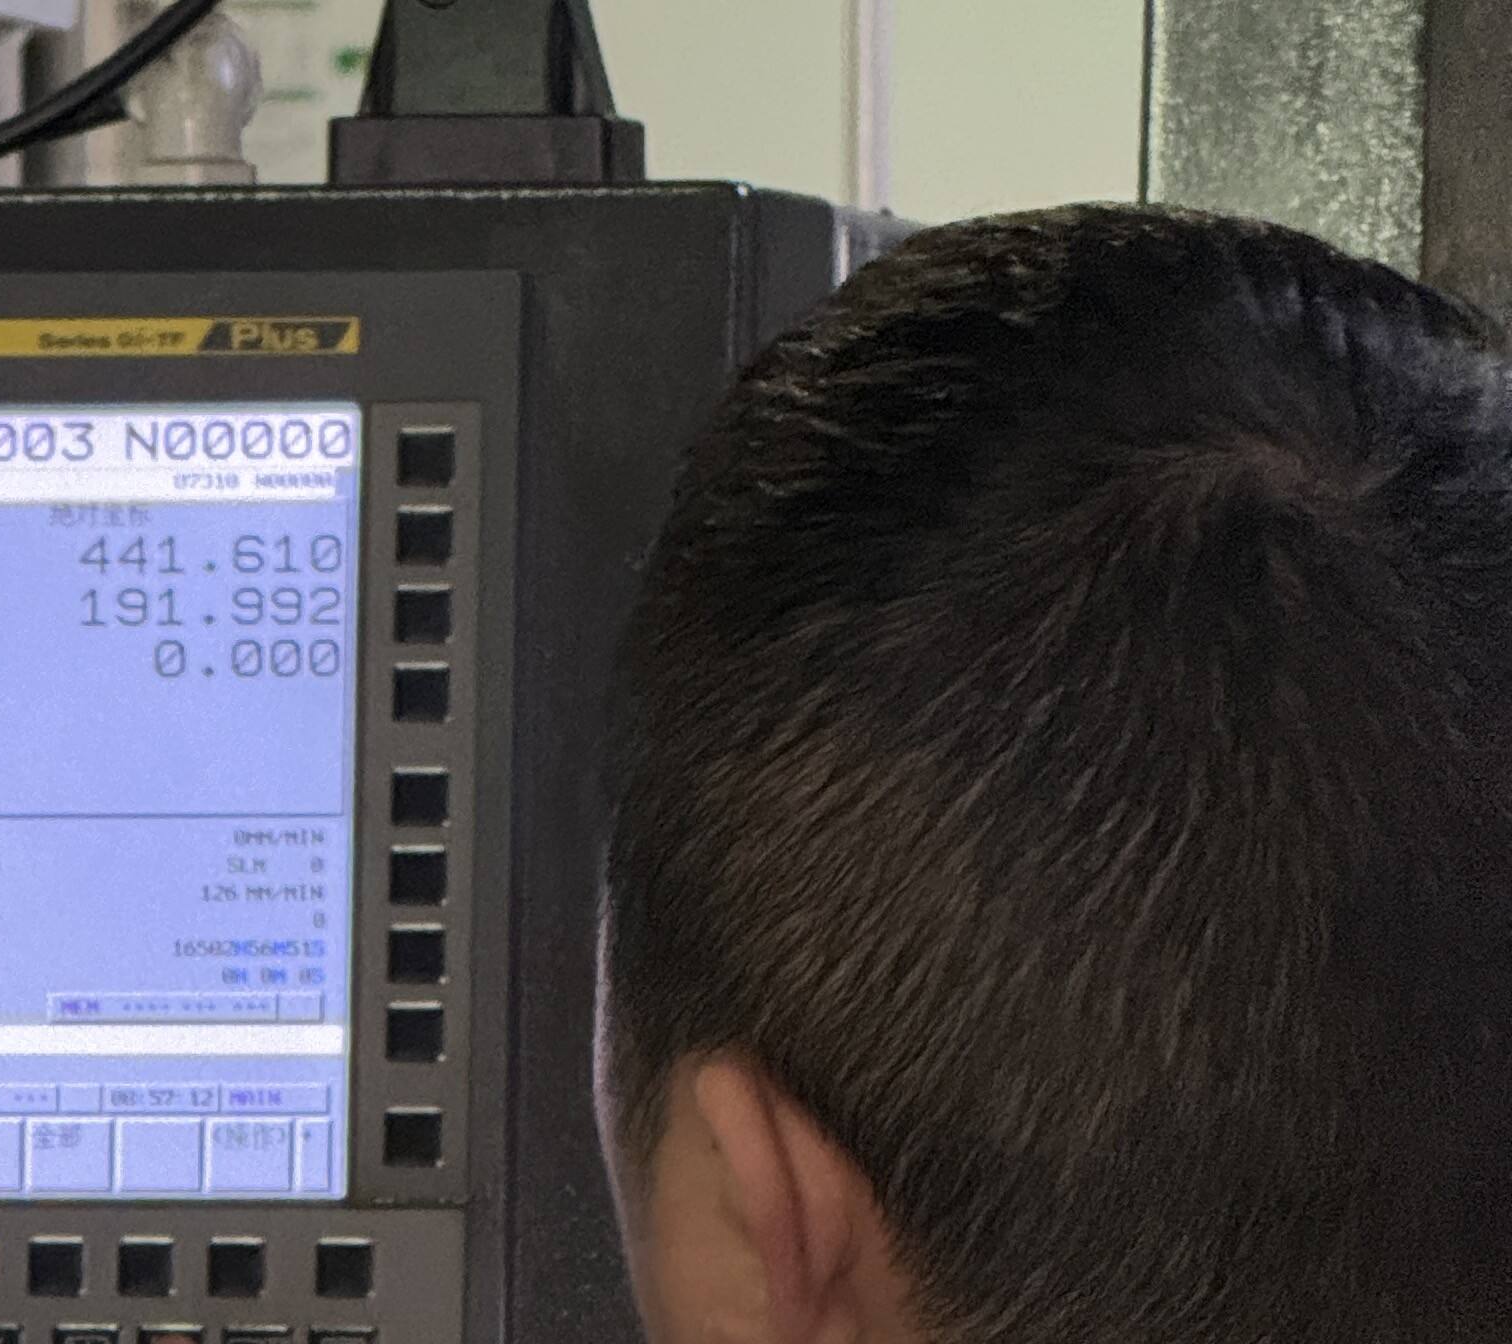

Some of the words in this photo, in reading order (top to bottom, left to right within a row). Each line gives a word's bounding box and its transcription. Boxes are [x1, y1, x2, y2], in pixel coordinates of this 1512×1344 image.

[231, 322, 318, 351] Plus
[125, 421, 350, 459] N00000
[79, 536, 342, 575] 441.610
[79, 588, 342, 627] 191.992
[154, 639, 341, 678] 0.000
[31, 1124, 82, 1148] 全部
